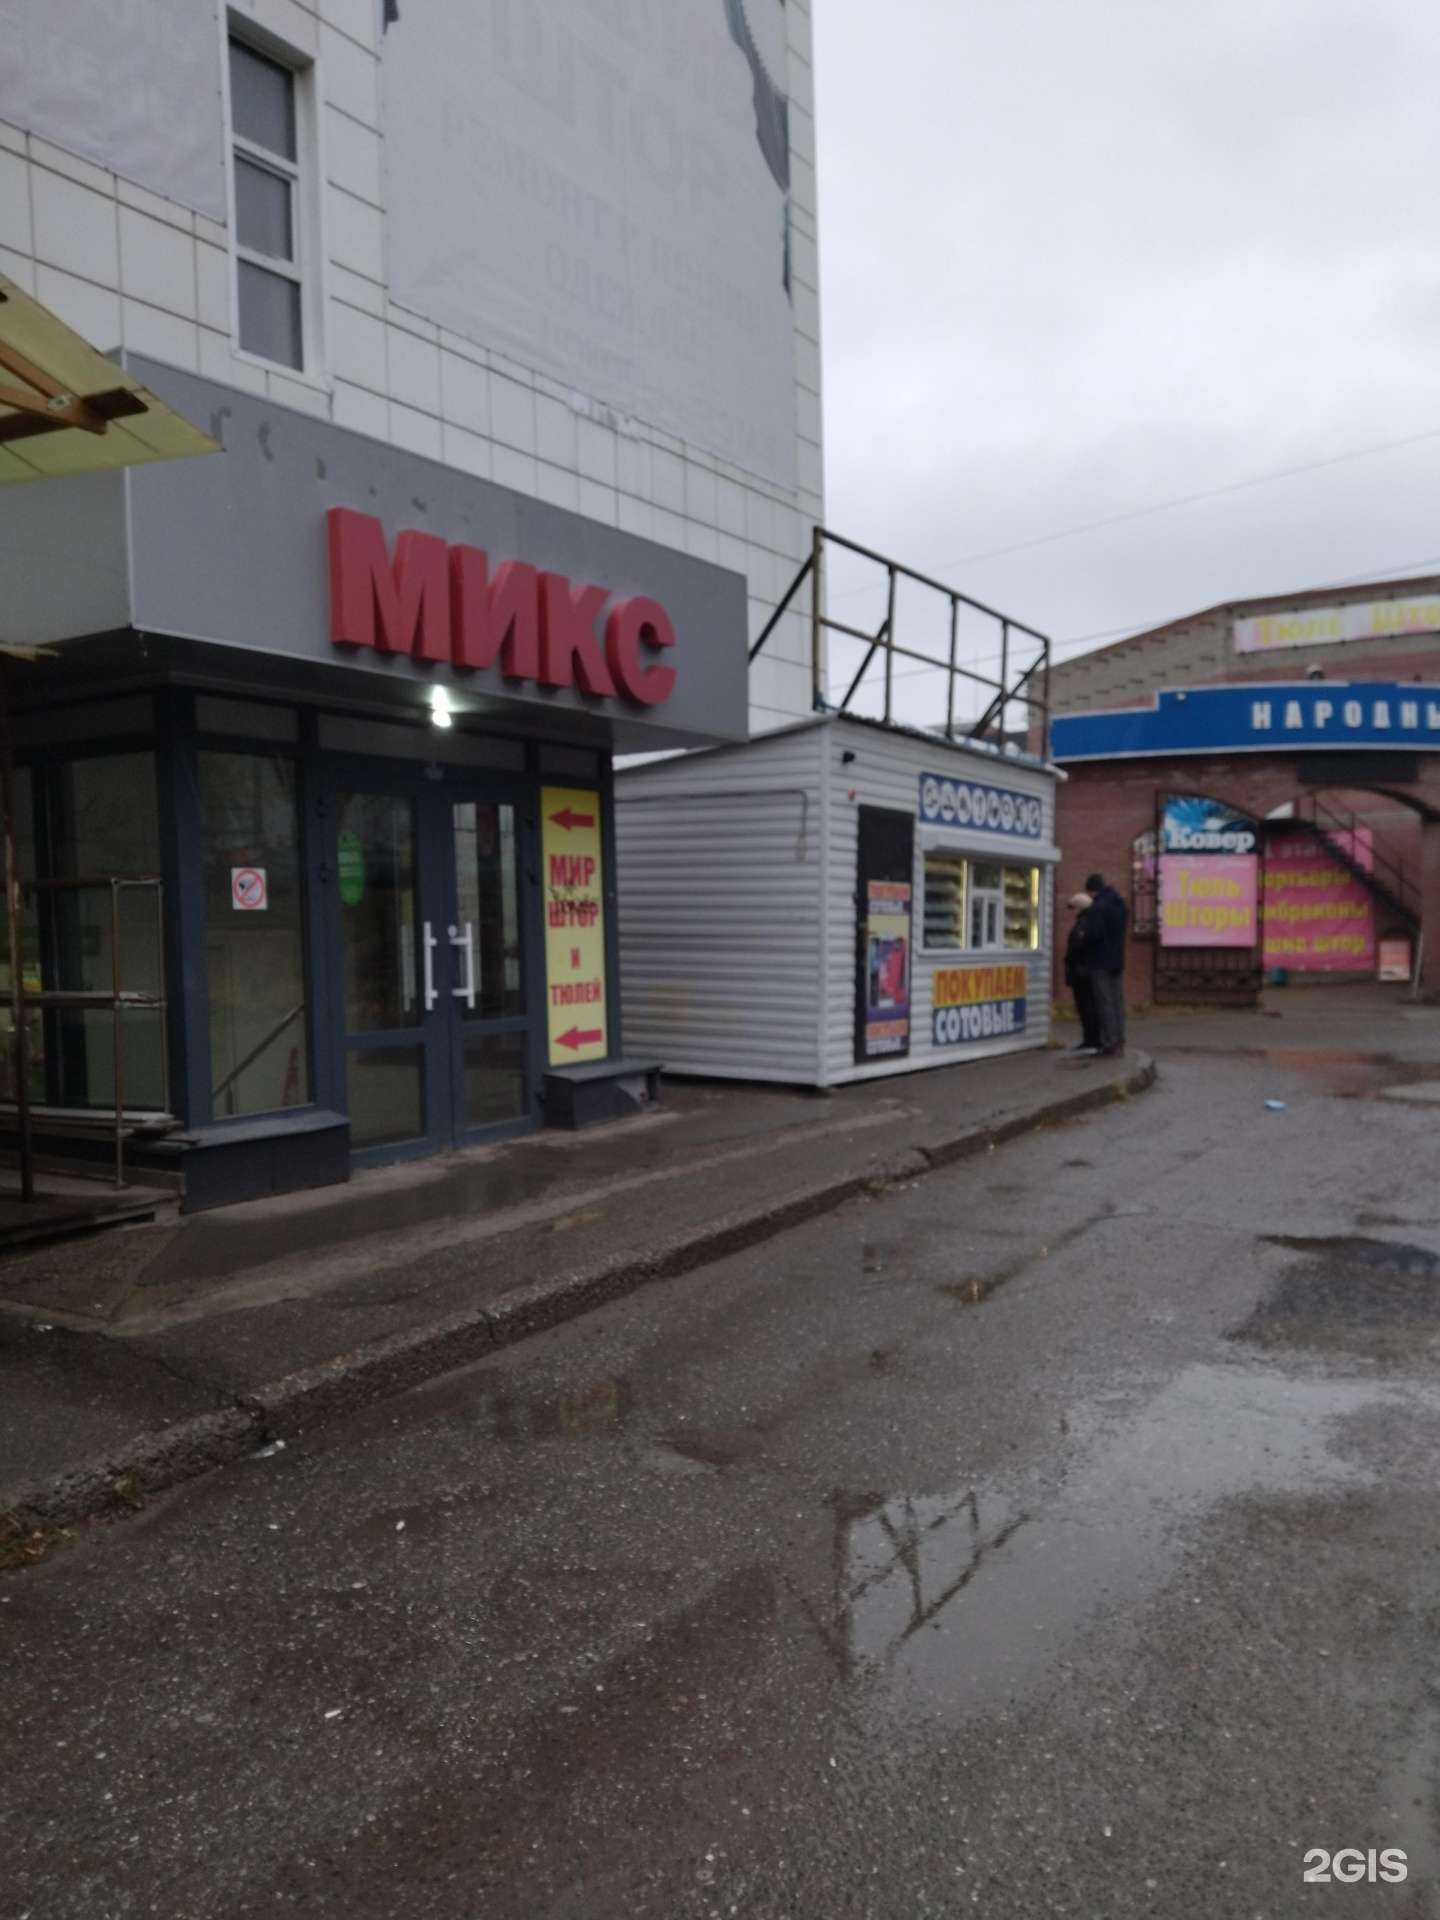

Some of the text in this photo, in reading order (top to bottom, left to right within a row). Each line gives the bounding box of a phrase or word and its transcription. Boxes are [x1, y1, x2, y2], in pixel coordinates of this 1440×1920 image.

[327, 506, 677, 706] МИКС
[1168, 827, 1256, 853] Ковер
[549, 855, 596, 887] МИР
[548, 901, 599, 928] ШТОР
[1166, 900, 1251, 933] Шторы
[550, 979, 601, 1006] ТЮЛЕЙ
[936, 1001, 1015, 1043] СОТОВЫЕ
